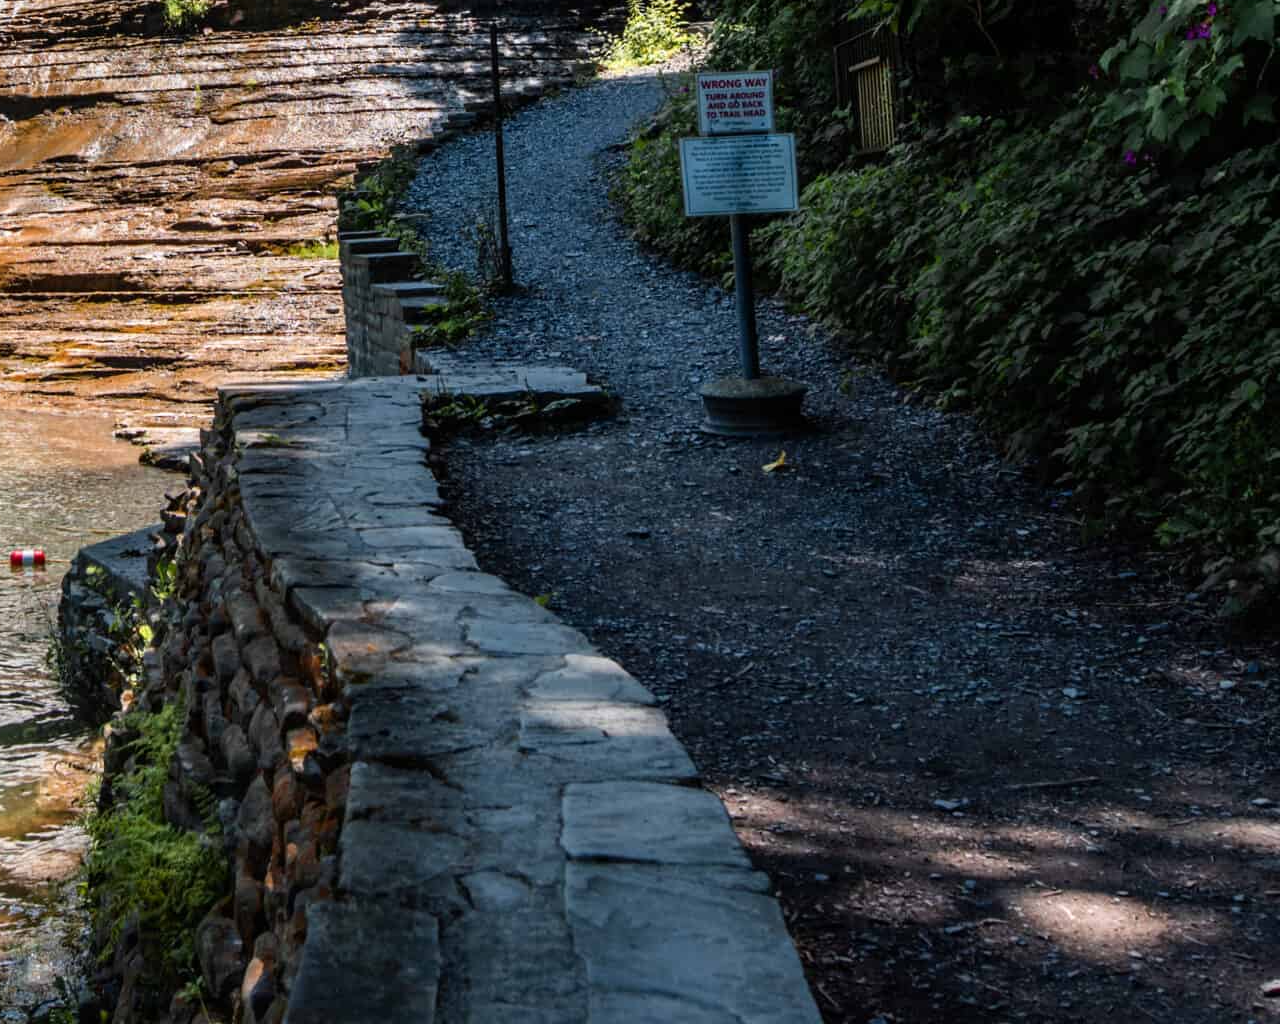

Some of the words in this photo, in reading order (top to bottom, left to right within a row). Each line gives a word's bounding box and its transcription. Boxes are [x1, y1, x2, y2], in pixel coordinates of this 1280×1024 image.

[701, 79, 742, 89] WRONG
[744, 78, 768, 87] WAY
[729, 91, 765, 100] AROUND
[727, 101, 740, 109] GO
[742, 100, 763, 108] BACK
[719, 110, 742, 118] TRAIL
[744, 109, 766, 117] HEAD
